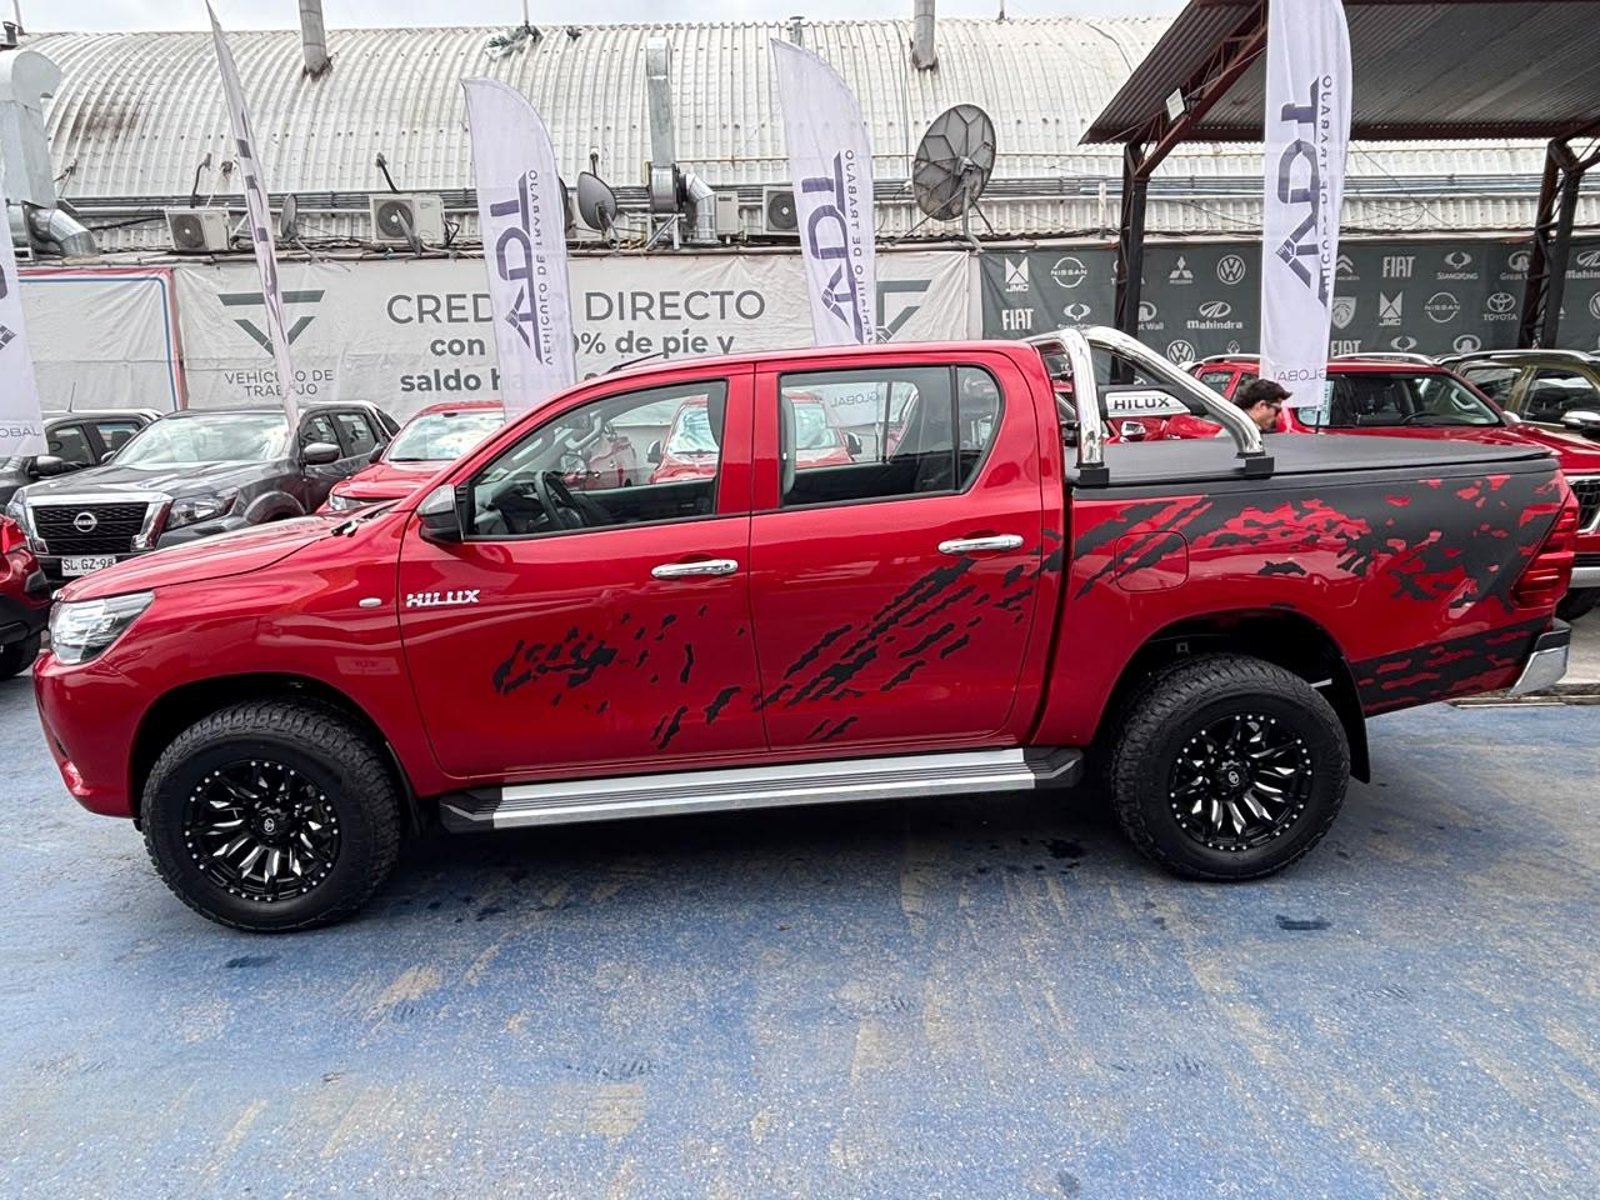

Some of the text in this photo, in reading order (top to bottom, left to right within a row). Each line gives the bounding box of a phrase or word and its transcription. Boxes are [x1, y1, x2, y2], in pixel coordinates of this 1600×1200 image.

[1382, 256, 1416, 278] FIAT
[387, 290, 766, 324] CRED DIRECTO
[1002, 308, 1034, 331] FIAT
[1483, 313, 1518, 321] TOYOTA
[429, 337, 486, 356] con
[615, 330, 652, 354] de
[716, 336, 735, 355] y
[1330, 339, 1362, 358] FIAT
[312, 369, 334, 381] DE
[400, 368, 482, 392] saldo
[1114, 397, 1170, 410] HILUX
[0, 426, 42, 439] OBAL
[406, 589, 481, 608] HILUX
